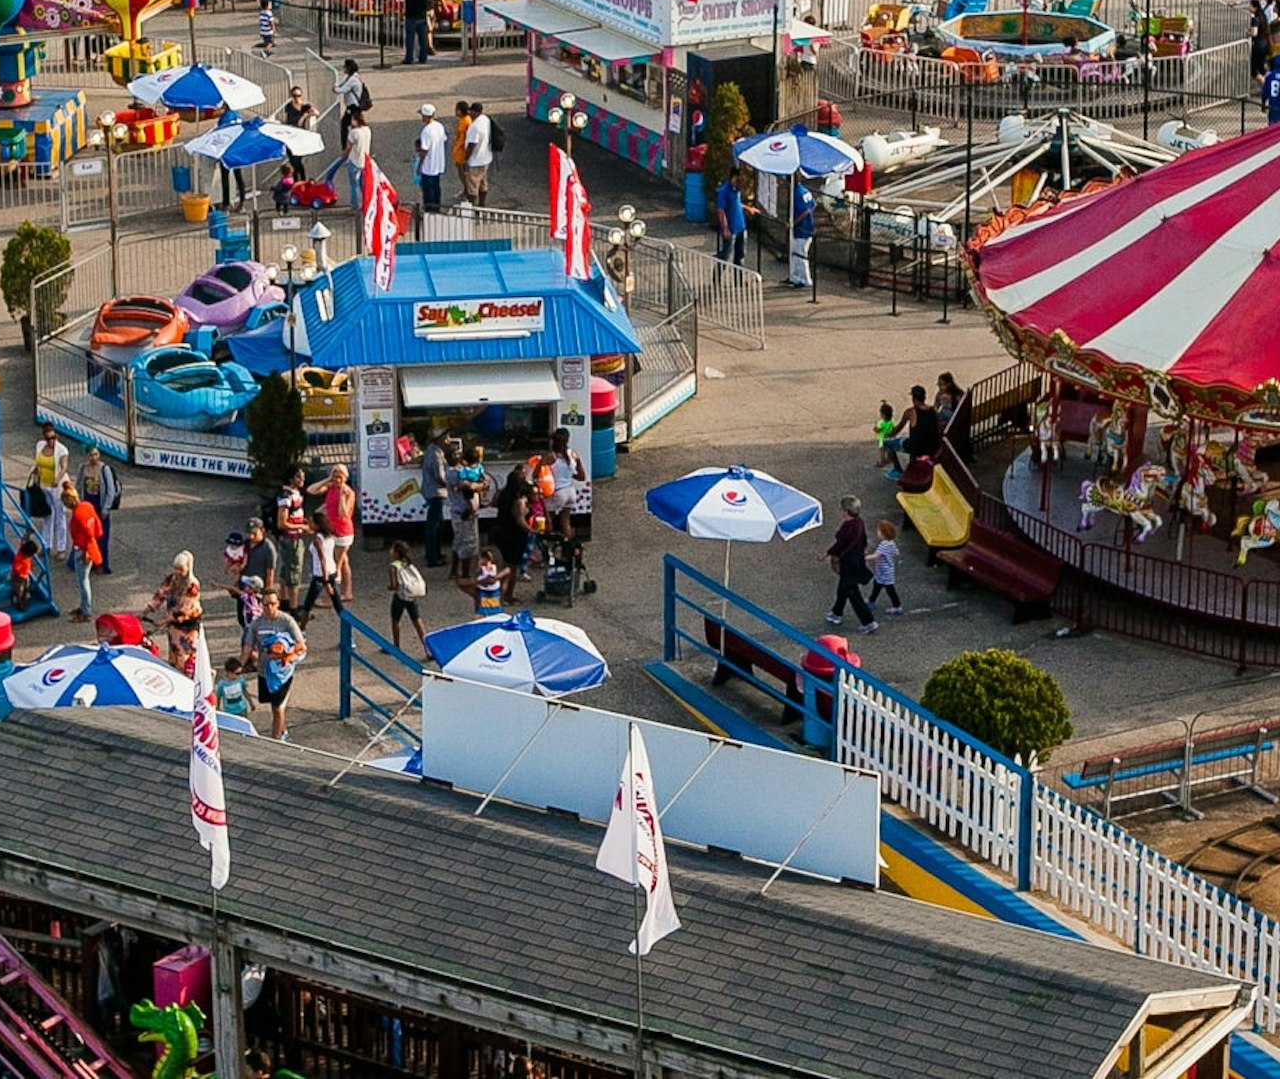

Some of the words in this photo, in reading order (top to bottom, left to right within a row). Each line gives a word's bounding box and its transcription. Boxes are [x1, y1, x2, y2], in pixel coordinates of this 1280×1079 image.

[417, 305, 448, 323] Say
[477, 300, 542, 318] Cheese!
[159, 451, 200, 469] WILLIE
[202, 458, 222, 472] THE
